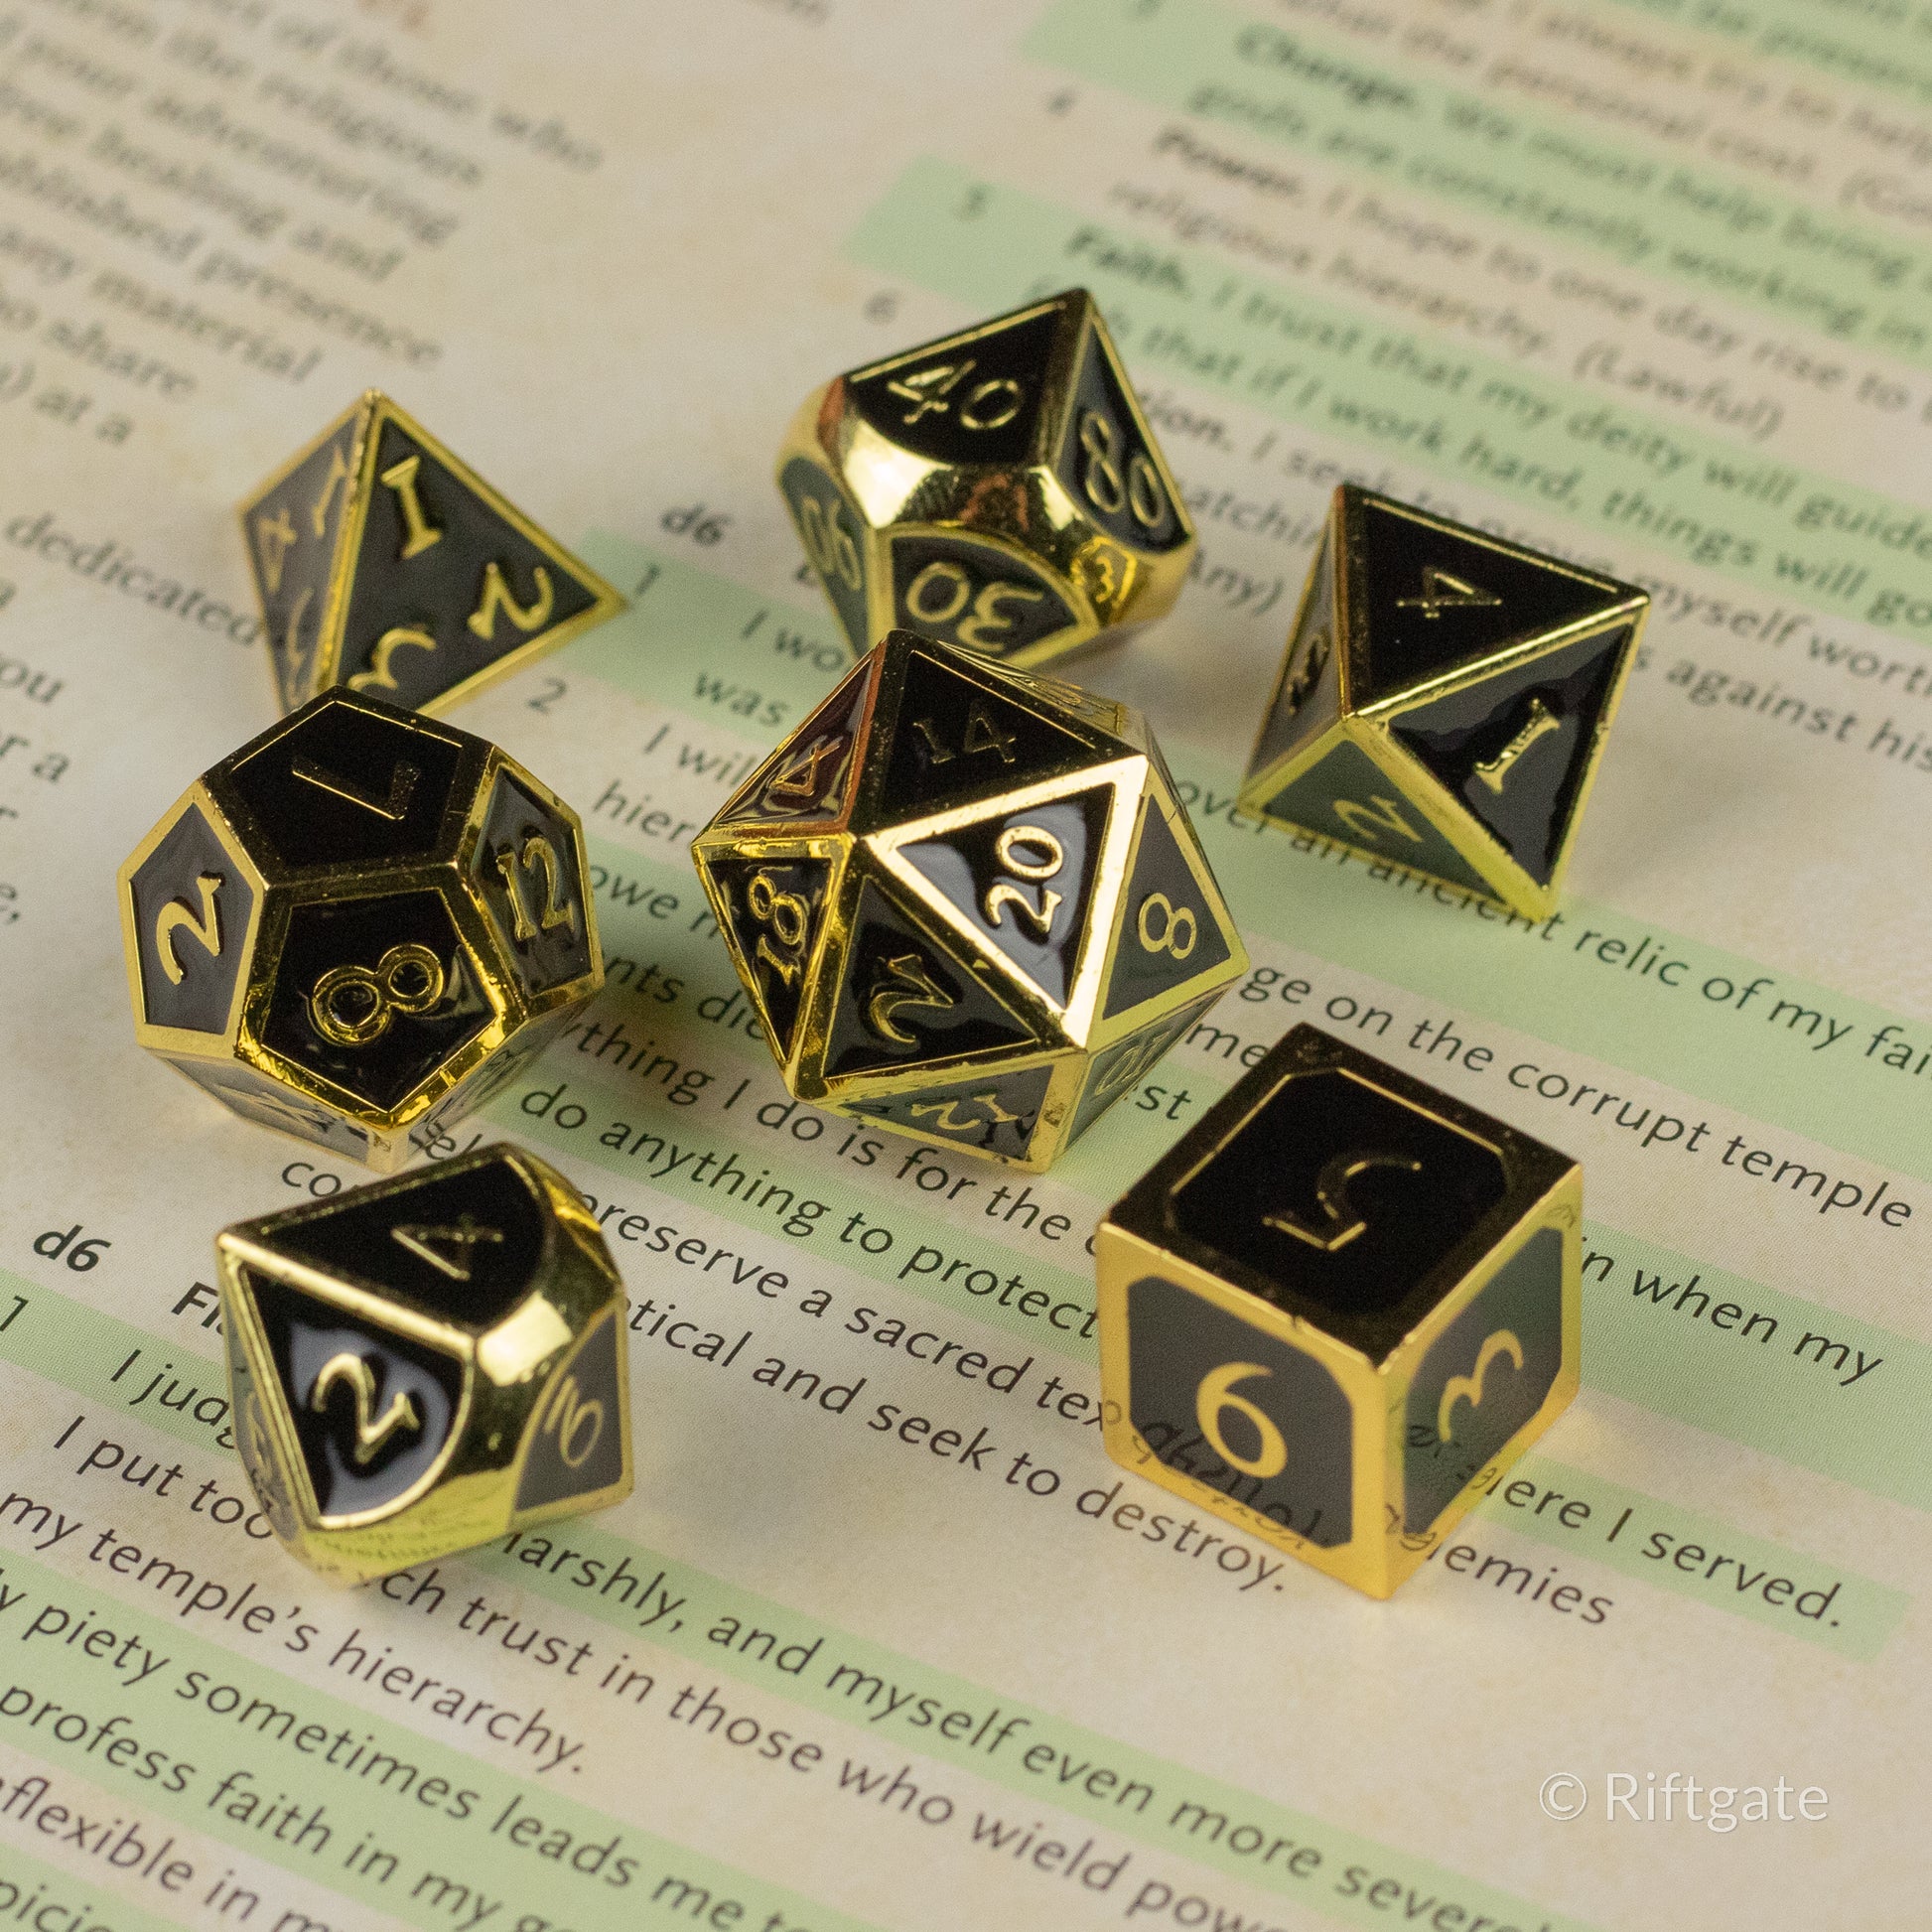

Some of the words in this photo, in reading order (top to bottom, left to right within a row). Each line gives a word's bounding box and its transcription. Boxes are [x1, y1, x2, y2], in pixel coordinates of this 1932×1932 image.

[888, 359, 1025, 431] 40
[659, 501, 736, 548] d6
[1078, 411, 1166, 529] 80
[1773, 546, 1869, 600] will
[694, 671, 791, 728] was
[1667, 659, 1861, 747] against
[1807, 632, 1932, 699] wort
[911, 700, 1017, 765] 14
[592, 776, 697, 843] hier
[156, 870, 225, 987] 2
[495, 836, 576, 942] 12
[747, 874, 807, 986] 18
[985, 825, 1064, 937] 20
[1136, 893, 1198, 960] 8
[311, 942, 446, 1048] 8
[525, 677, 570, 717] 2
[640, 723, 672, 756] I
[1325, 995, 1396, 1037] on
[1407, 1019, 1496, 1075] the
[1506, 1061, 1713, 1154] corrupt
[1721, 1134, 1914, 1228] temple
[1574, 936, 1691, 987] relic
[1701, 977, 1775, 1011] of
[1767, 1000, 1855, 1052] my
[1864, 1025, 1932, 1077] fai
[519, 1083, 590, 1130] do
[598, 1120, 832, 1239] anything
[838, 1211, 895, 1255] to
[897, 1243, 1099, 1339] protect
[724, 1077, 753, 1111] I
[755, 1099, 826, 1143] do
[835, 1123, 885, 1168] is
[895, 1146, 978, 1201] for
[983, 1184, 1073, 1242] the
[32, 1223, 113, 1274] d6
[1630, 1268, 1779, 1345] when
[1792, 1330, 1885, 1388] my
[311, 1351, 422, 1465] 2
[798, 1288, 835, 1319] a
[844, 1305, 1035, 1396] sacred
[1428, 1544, 1615, 1625] emies
[1195, 1359, 1290, 1479] 6
[751, 1355, 868, 1417] and
[867, 1403, 999, 1472] seek
[1005, 1451, 1061, 1497] to
[1074, 1480, 1287, 1593] destroy.
[109, 1348, 142, 1384] I
[706, 1615, 825, 1676] and
[825, 1663, 1033, 1754] myself
[1023, 1743, 1156, 1814] even
[1168, 1801, 1323, 1879] more
[1606, 1507, 1634, 1544] I
[1640, 1530, 1844, 1629] served.
[0, 1491, 84, 1552] my
[328, 1627, 585, 1775] hierarchy.
[53, 1414, 85, 1449] I
[75, 1439, 185, 1497] put
[457, 1595, 595, 1678] trust
[599, 1652, 657, 1706] in
[667, 1685, 824, 1774] those
[838, 1757, 956, 1827] who
[969, 1811, 1134, 1894] wield
[21, 1604, 172, 1688] piety
[174, 1670, 482, 1820] sometimes
[489, 1794, 641, 1888] leads
[649, 1874, 747, 1932] me
[0, 1775, 195, 1893] flexible
[203, 1868, 260, 1923] in
[207, 1770, 334, 1856] faith
[344, 1831, 401, 1883] in
[409, 1870, 504, 1932] my
